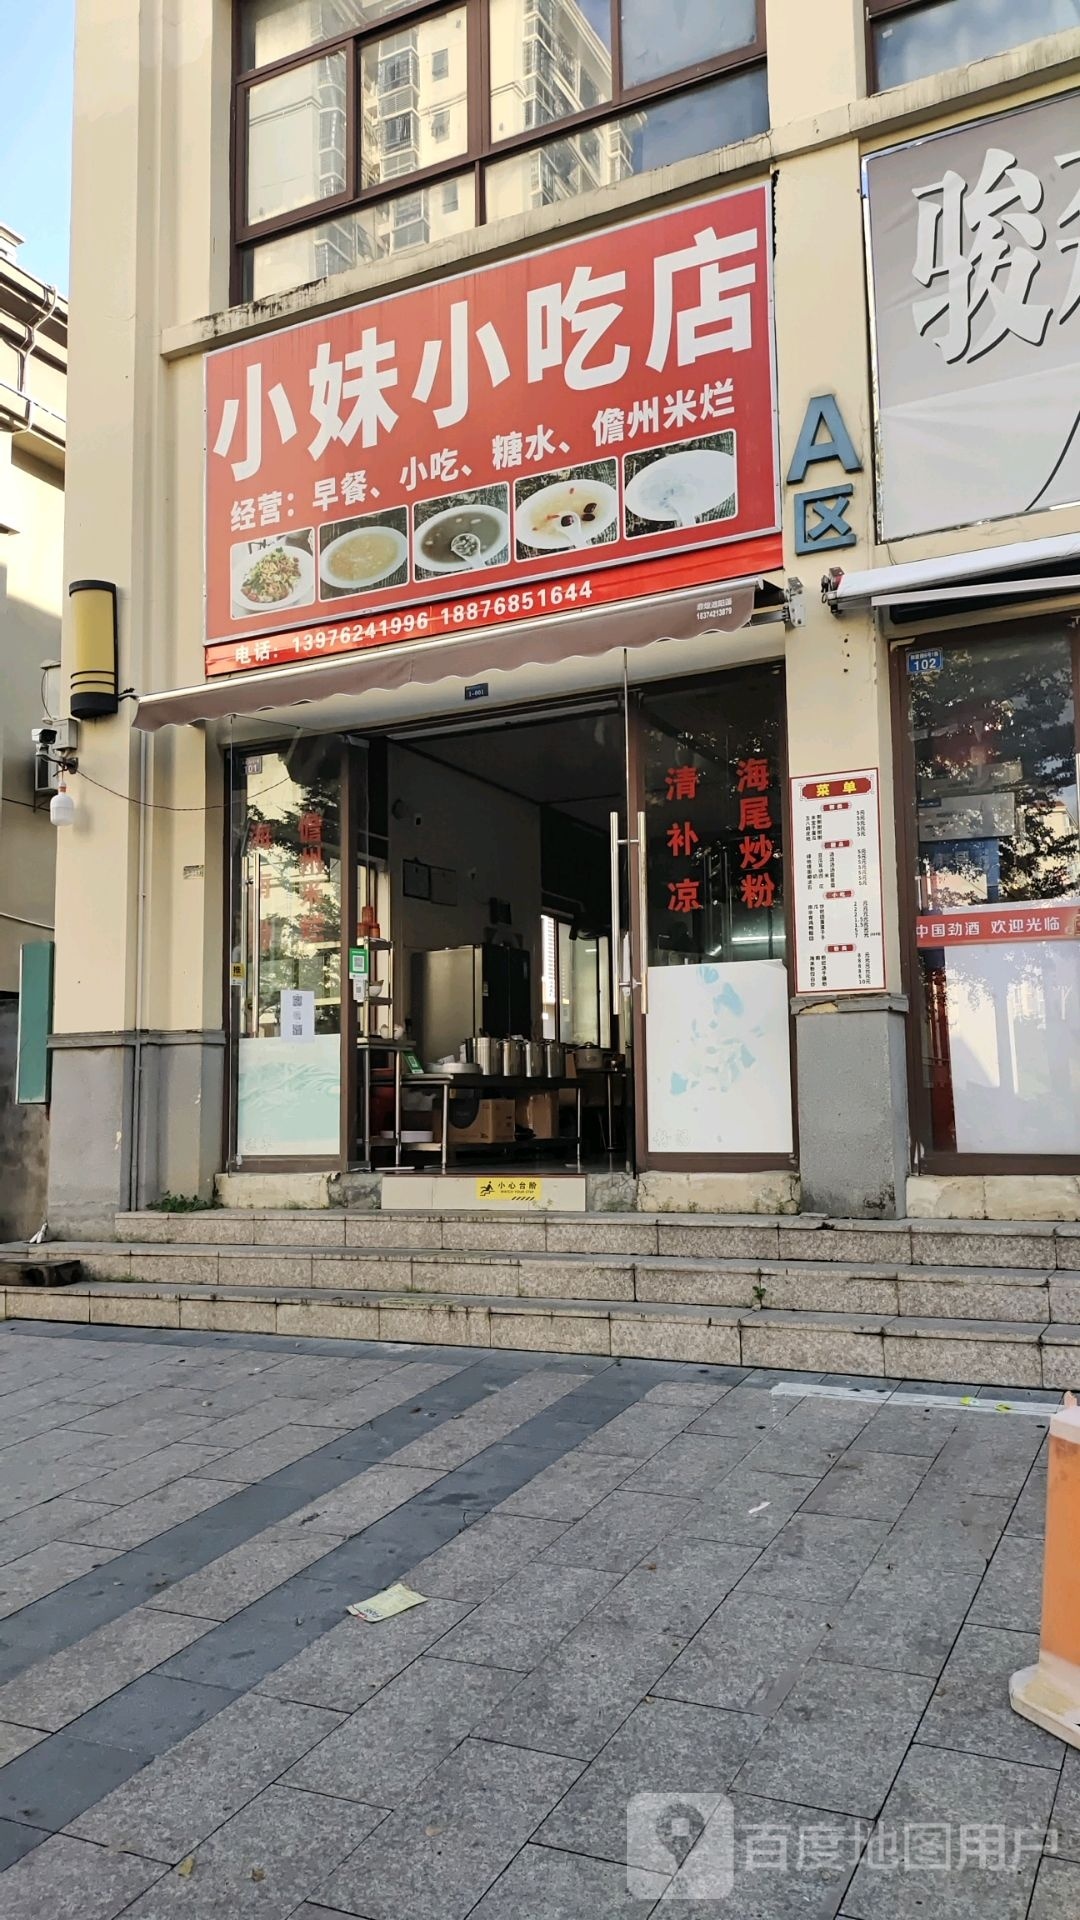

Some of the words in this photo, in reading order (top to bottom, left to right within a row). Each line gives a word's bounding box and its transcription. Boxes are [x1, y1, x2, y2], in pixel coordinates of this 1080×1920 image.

[911, 147, 1080, 365] 骏
[213, 227, 759, 482] 小妹小吃店
[292, 611, 429, 653] 13976241996
[441, 580, 593, 625] 18876851644
[913, 658, 937, 671] 102
[815, 781, 857, 797] 菜单
[664, 765, 702, 913] 清补凉
[736, 758, 776, 909] 海尾炒粉
[916, 921, 980, 938] 中国劲酒
[991, 917, 1060, 934] 欢迎光临
[498, 1181, 537, 1190] 小心台阶
